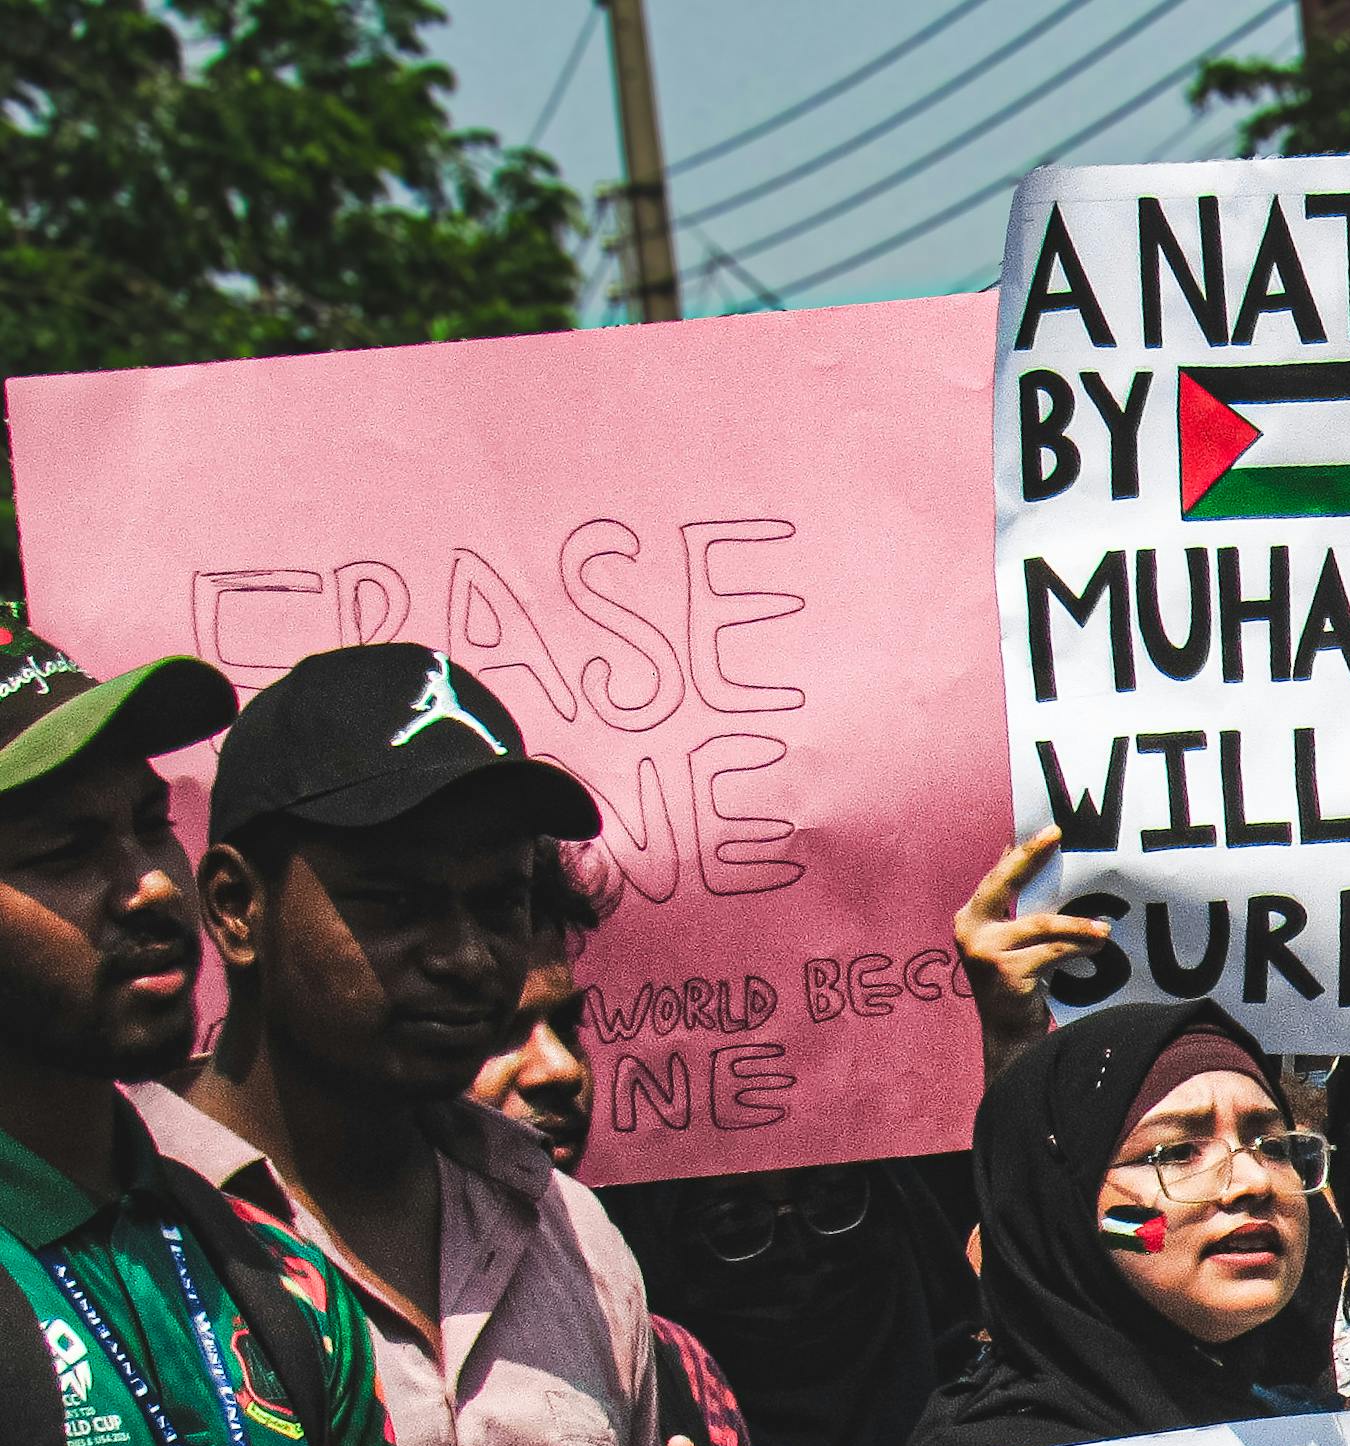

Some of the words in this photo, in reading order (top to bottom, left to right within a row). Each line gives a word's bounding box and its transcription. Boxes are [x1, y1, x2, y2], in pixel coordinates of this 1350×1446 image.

[1014, 200, 1117, 350] A
[1018, 367, 1153, 502] BY
[585, 975, 779, 1045] WORLD
